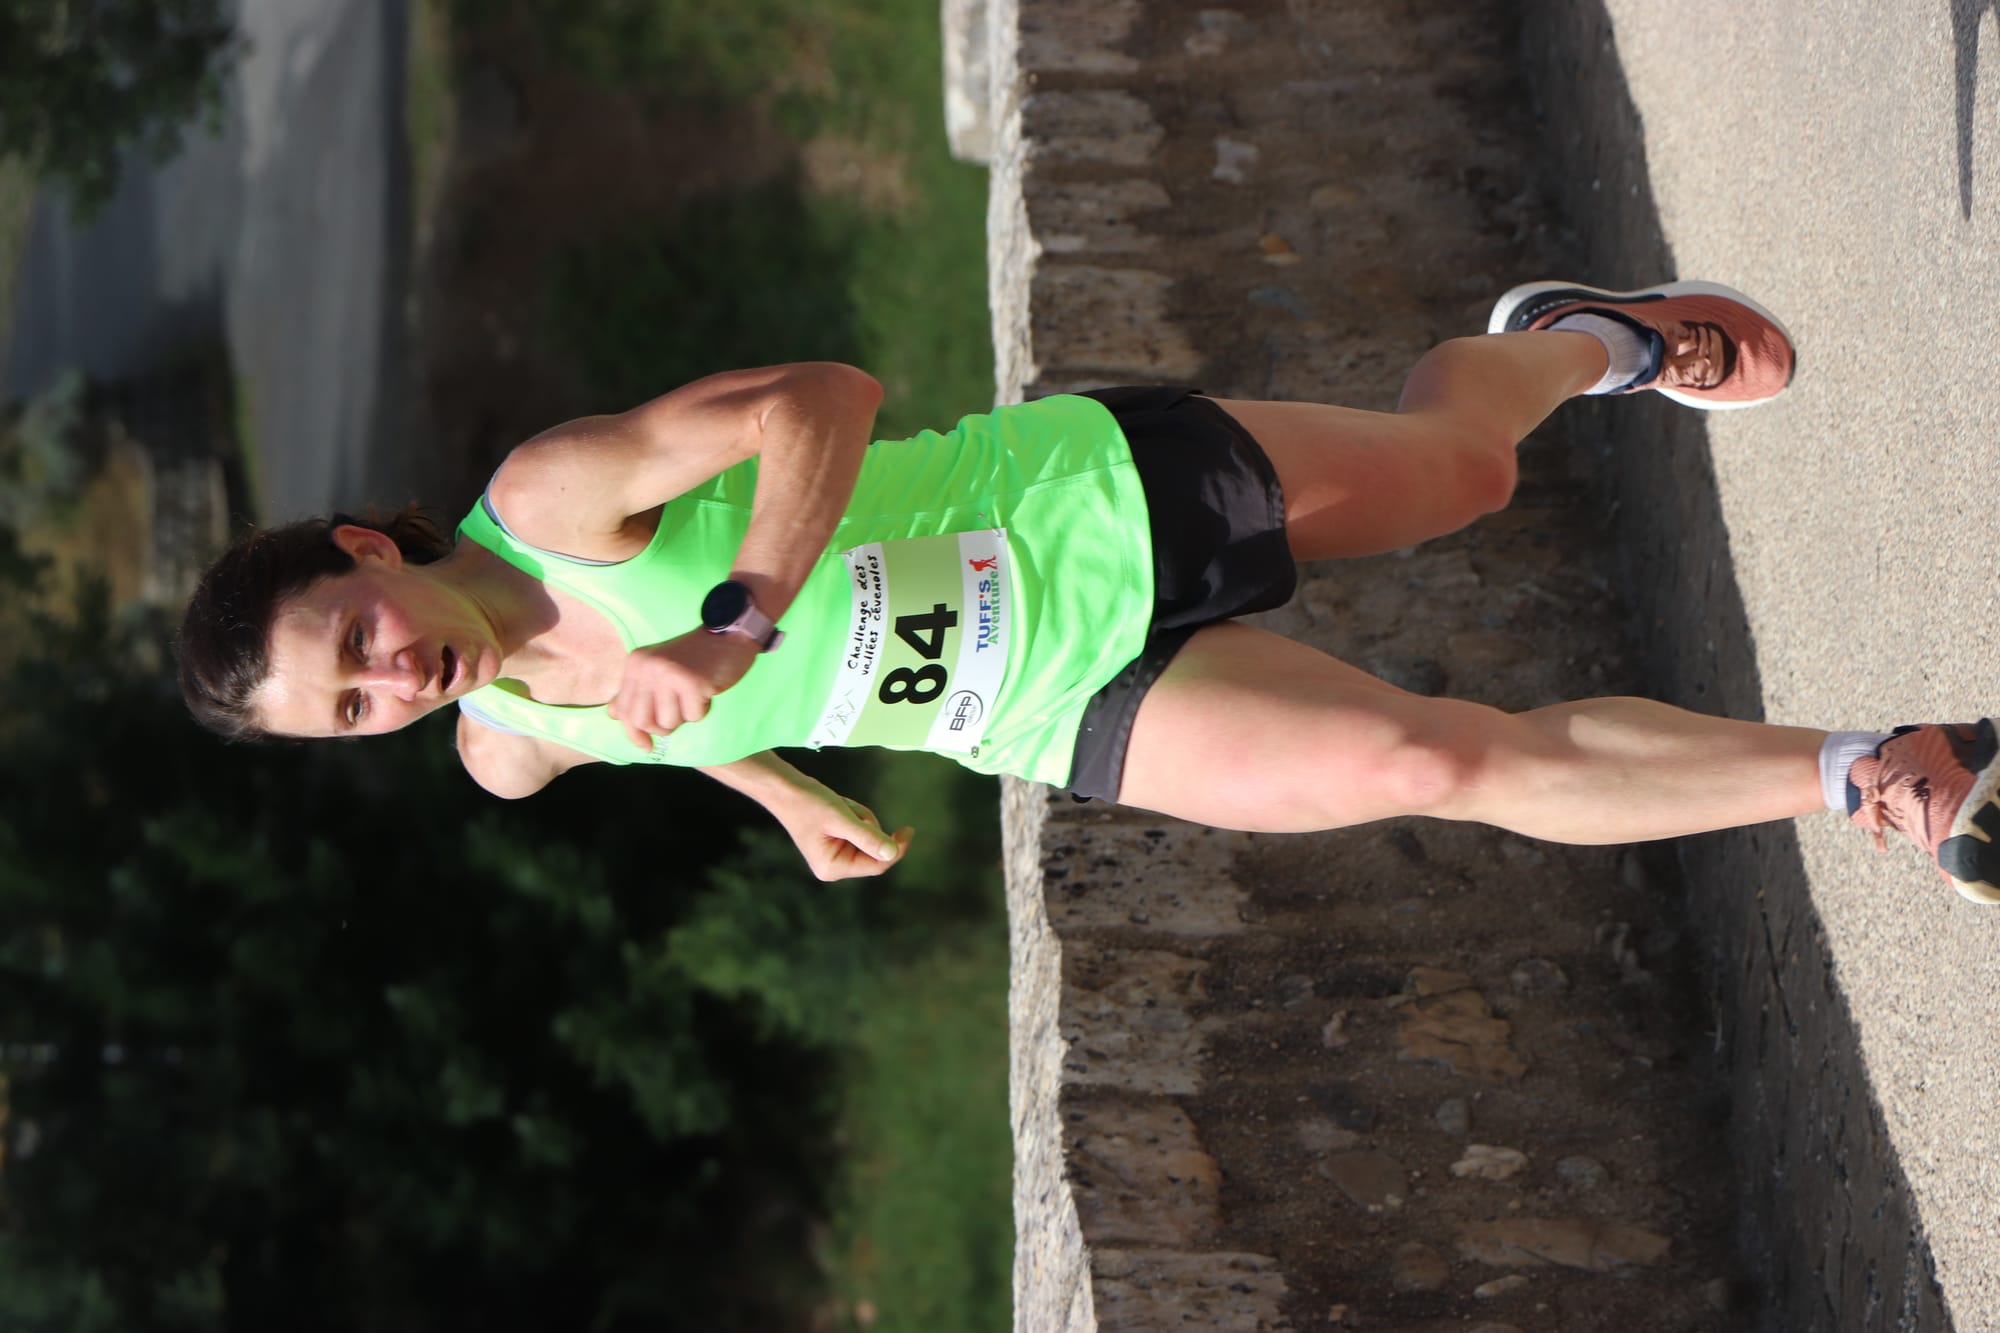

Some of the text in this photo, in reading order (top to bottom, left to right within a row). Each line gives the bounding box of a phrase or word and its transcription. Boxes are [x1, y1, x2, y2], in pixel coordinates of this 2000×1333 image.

[847, 564, 872, 670] Challenge des
[861, 554, 882, 676] vallées cévenoles
[976, 579, 991, 653] TUFF'S
[986, 570, 1001, 645] Aventure
[878, 603, 958, 704] 84
[949, 696, 972, 731] BFP
